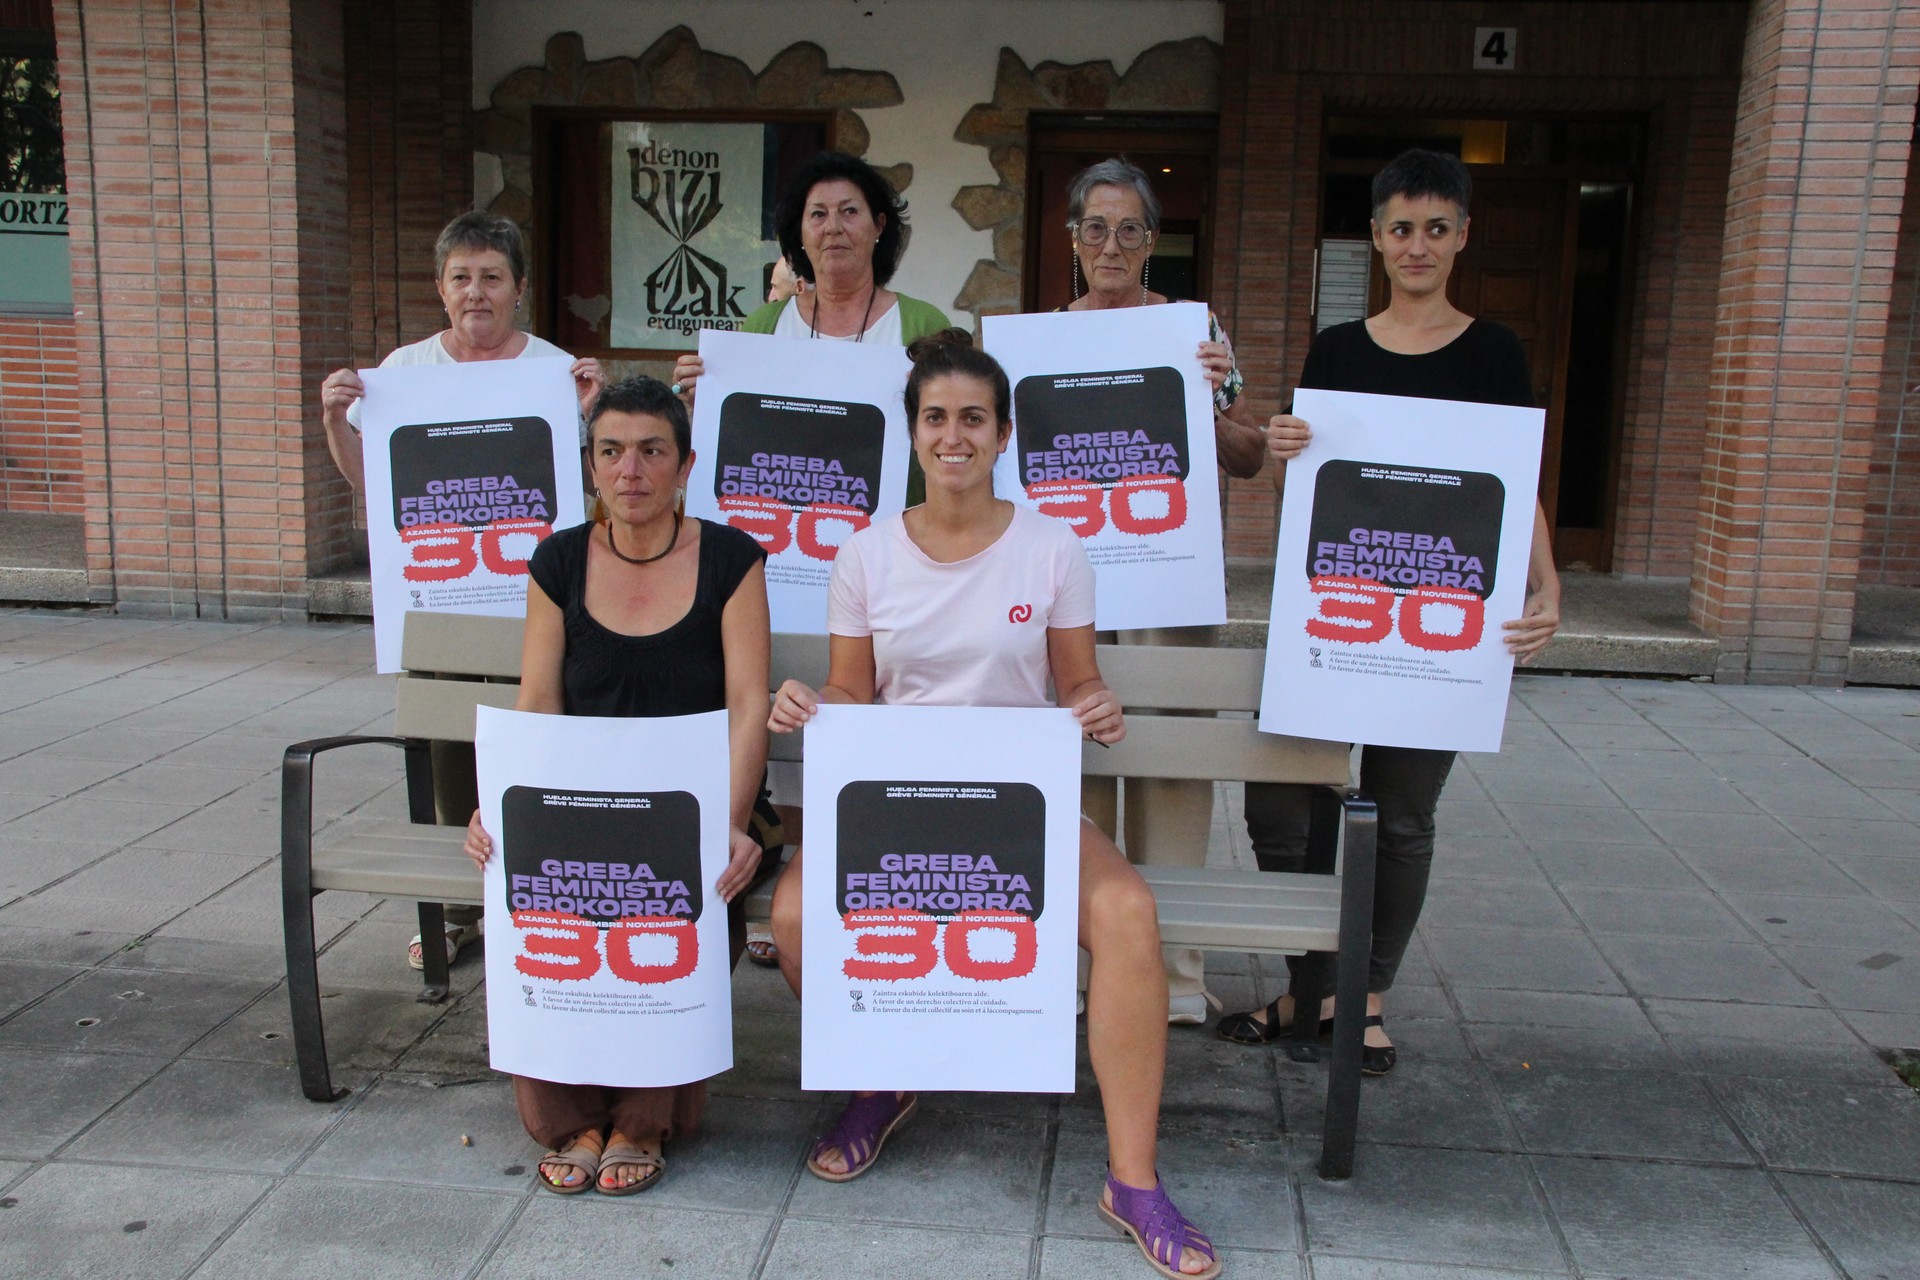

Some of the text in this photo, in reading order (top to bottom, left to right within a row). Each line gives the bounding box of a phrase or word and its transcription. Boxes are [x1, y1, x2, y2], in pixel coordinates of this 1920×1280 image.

[1481, 32, 1508, 64] 4
[641, 140, 720, 168] denon
[626, 148, 724, 244] bizi
[0, 199, 70, 225] ORTZ
[643, 243, 748, 318] tzak
[1053, 429, 1149, 449] GREBA
[752, 453, 844, 474] GREBA
[1026, 443, 1178, 467] FEMINISTA
[723, 465, 868, 492] FEMINISTA
[1026, 459, 1180, 482] OROKORRA
[1424, 478, 1461, 486] GÉNÉRALE
[426, 476, 518, 495] GREBA
[721, 481, 869, 507] OROKORRA
[1071, 481, 1124, 491] NOVIEMBRE
[1126, 477, 1176, 487] NOVEMBRE
[401, 489, 546, 511] FEMINISTA
[724, 499, 864, 517] AZAROA NOVIEMBRE NOVEMBRE
[1024, 474, 1187, 538] 30
[401, 504, 548, 526] OROKORRA
[444, 524, 494, 534] NOVIEMBRE
[496, 521, 545, 530] NOVEMBRE
[716, 493, 871, 562] 30
[399, 518, 554, 583] 30
[1349, 528, 1455, 553] GREBA
[1317, 542, 1484, 573] FEMINISTA
[1314, 559, 1484, 590] OROKORRA
[1316, 580, 1477, 601] AZAROA NOVIEMBRE NOVEMBRE
[1304, 573, 1485, 652] 30
[1380, 655, 1420, 664] kolektiboaren
[541, 859, 656, 880] GREBA
[880, 854, 998, 872] GREBA
[512, 874, 690, 898] FEMINISTA
[847, 873, 1031, 892] FEMINISTA
[511, 893, 692, 916] OROKORRA
[844, 892, 1033, 910] OROKORRA
[517, 914, 687, 929] AZAROA NOVIEMBRE NOVEMBRE
[510, 908, 699, 986] 30
[840, 905, 1038, 983] 30
